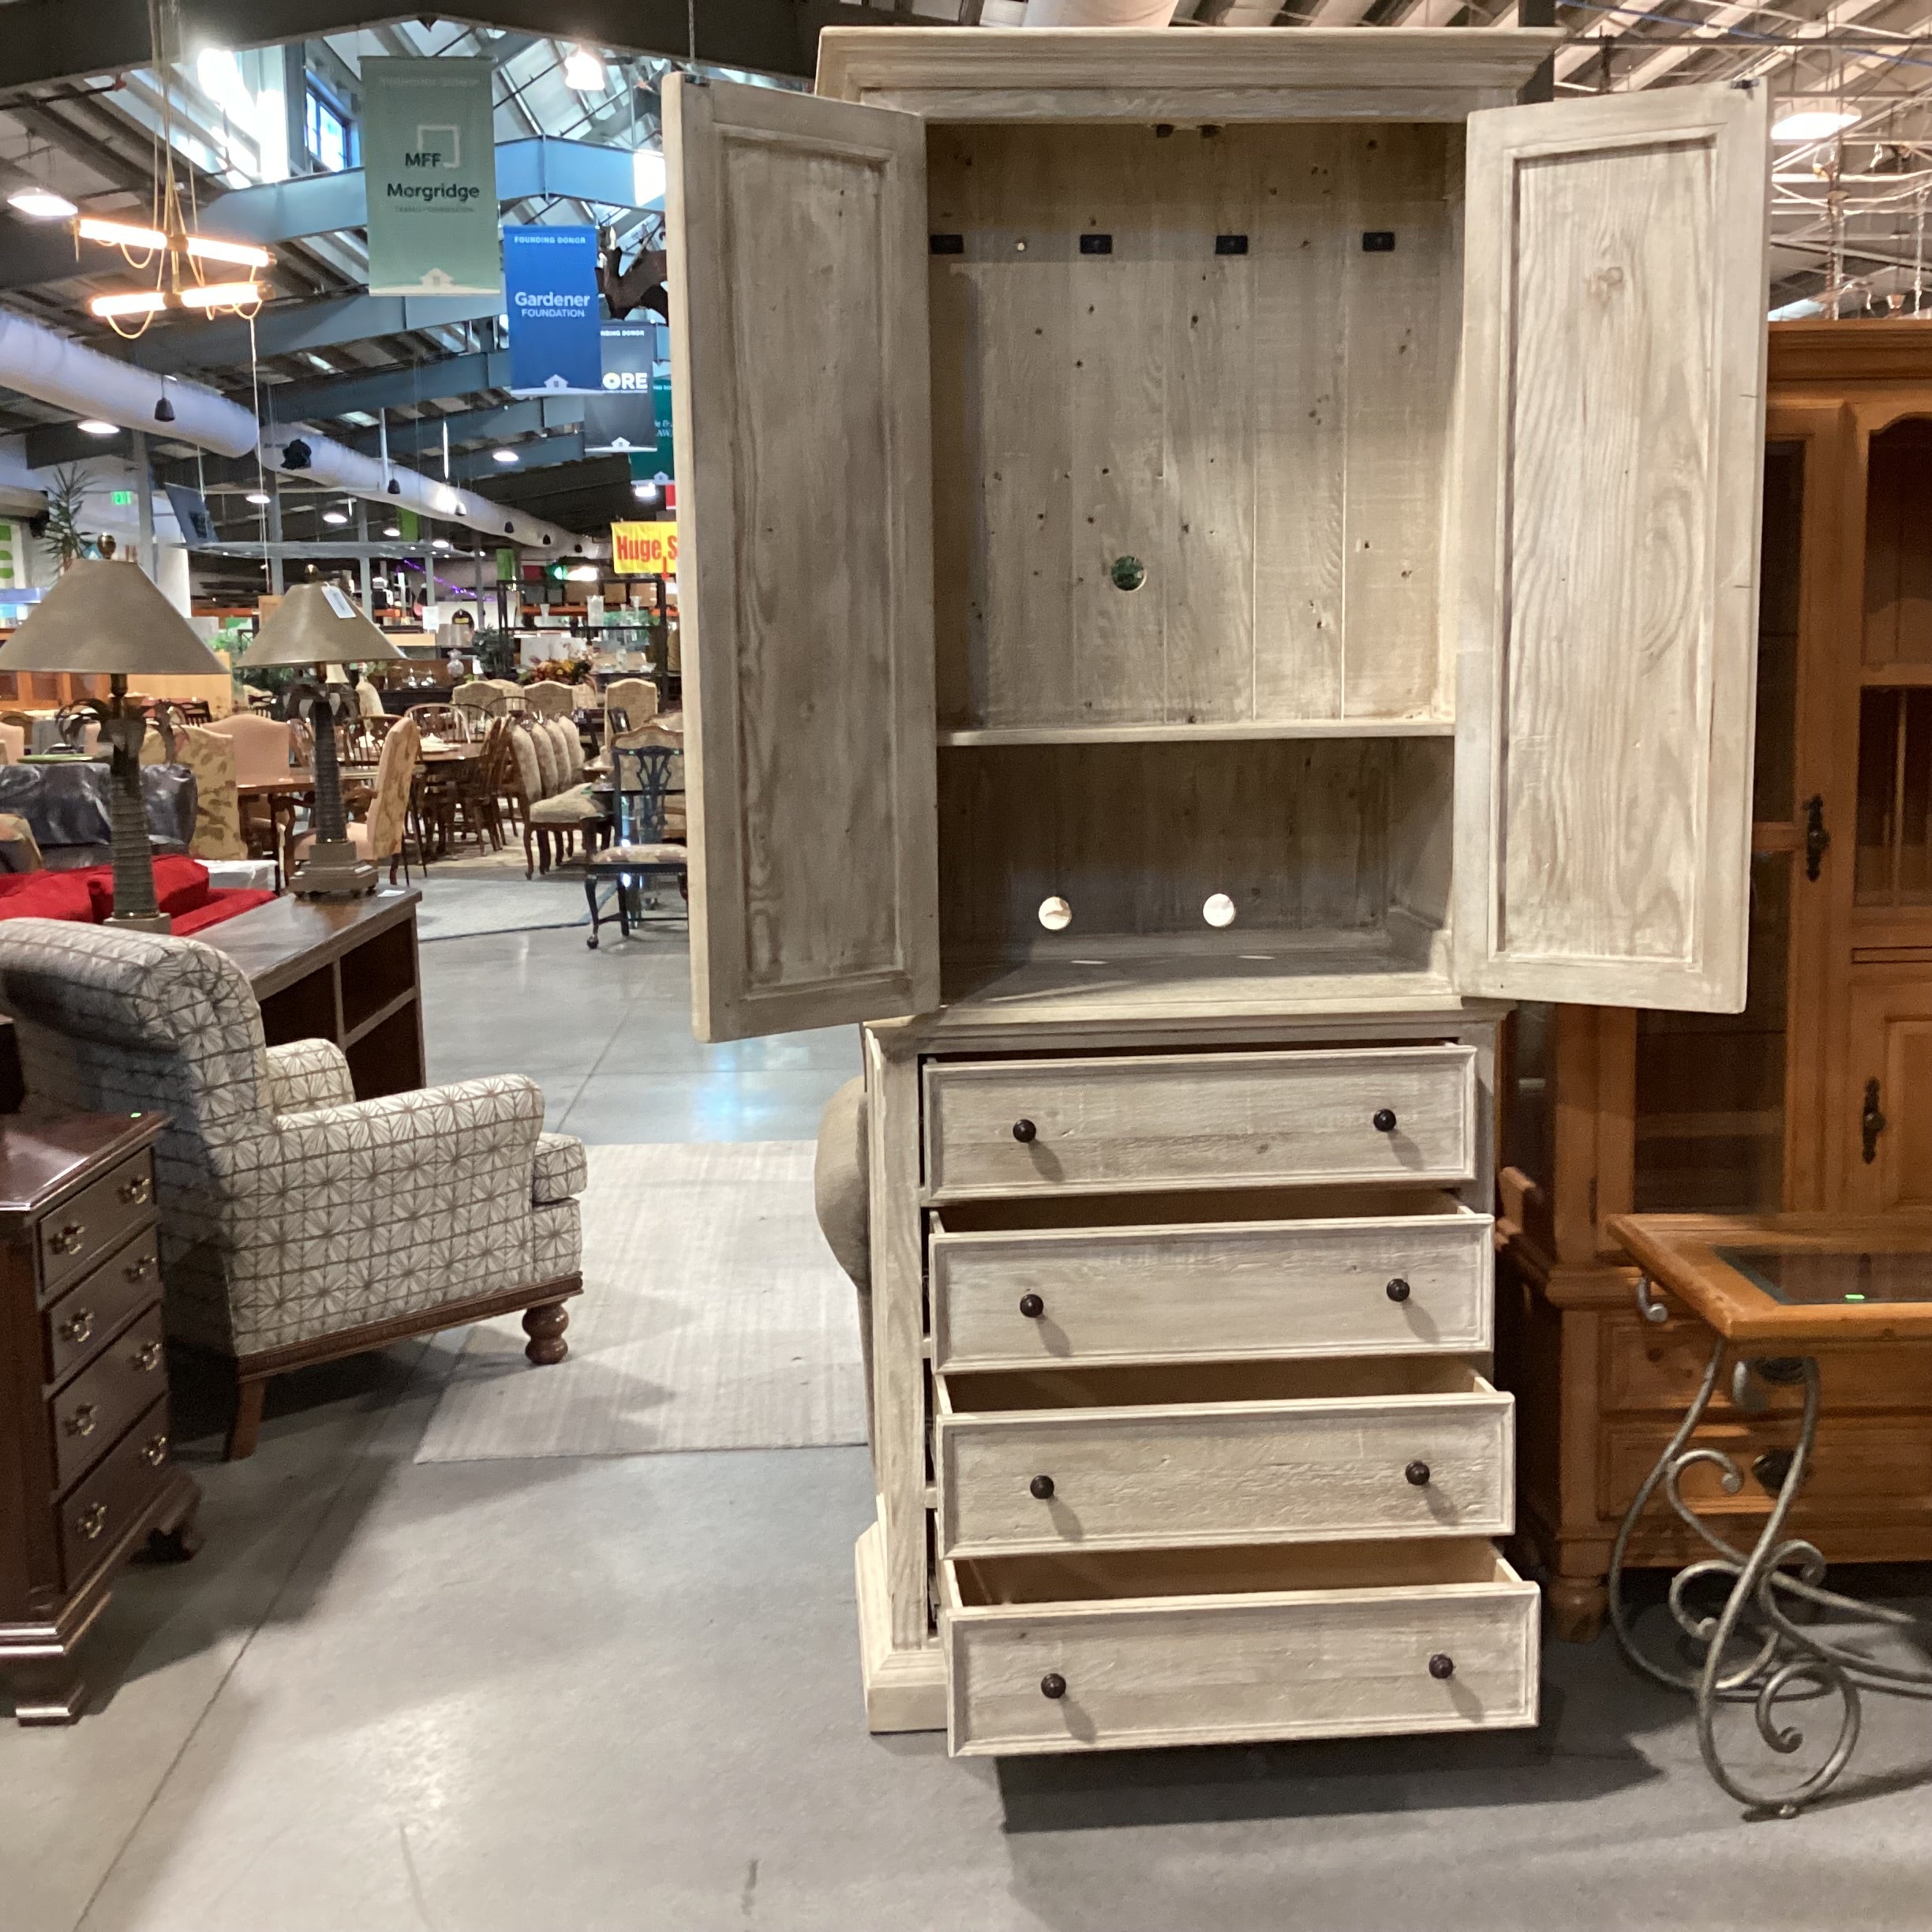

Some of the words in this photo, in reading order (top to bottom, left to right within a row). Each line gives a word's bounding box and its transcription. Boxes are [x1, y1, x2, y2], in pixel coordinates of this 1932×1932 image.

[405, 152, 442, 167] MFF
[387, 182, 480, 202] Morgridge
[515, 290, 590, 306] Gardener
[521, 309, 586, 317] FOUNDATION
[602, 372, 648, 390] ORE
[616, 535, 662, 563] Huge
[667, 534, 678, 560] S
